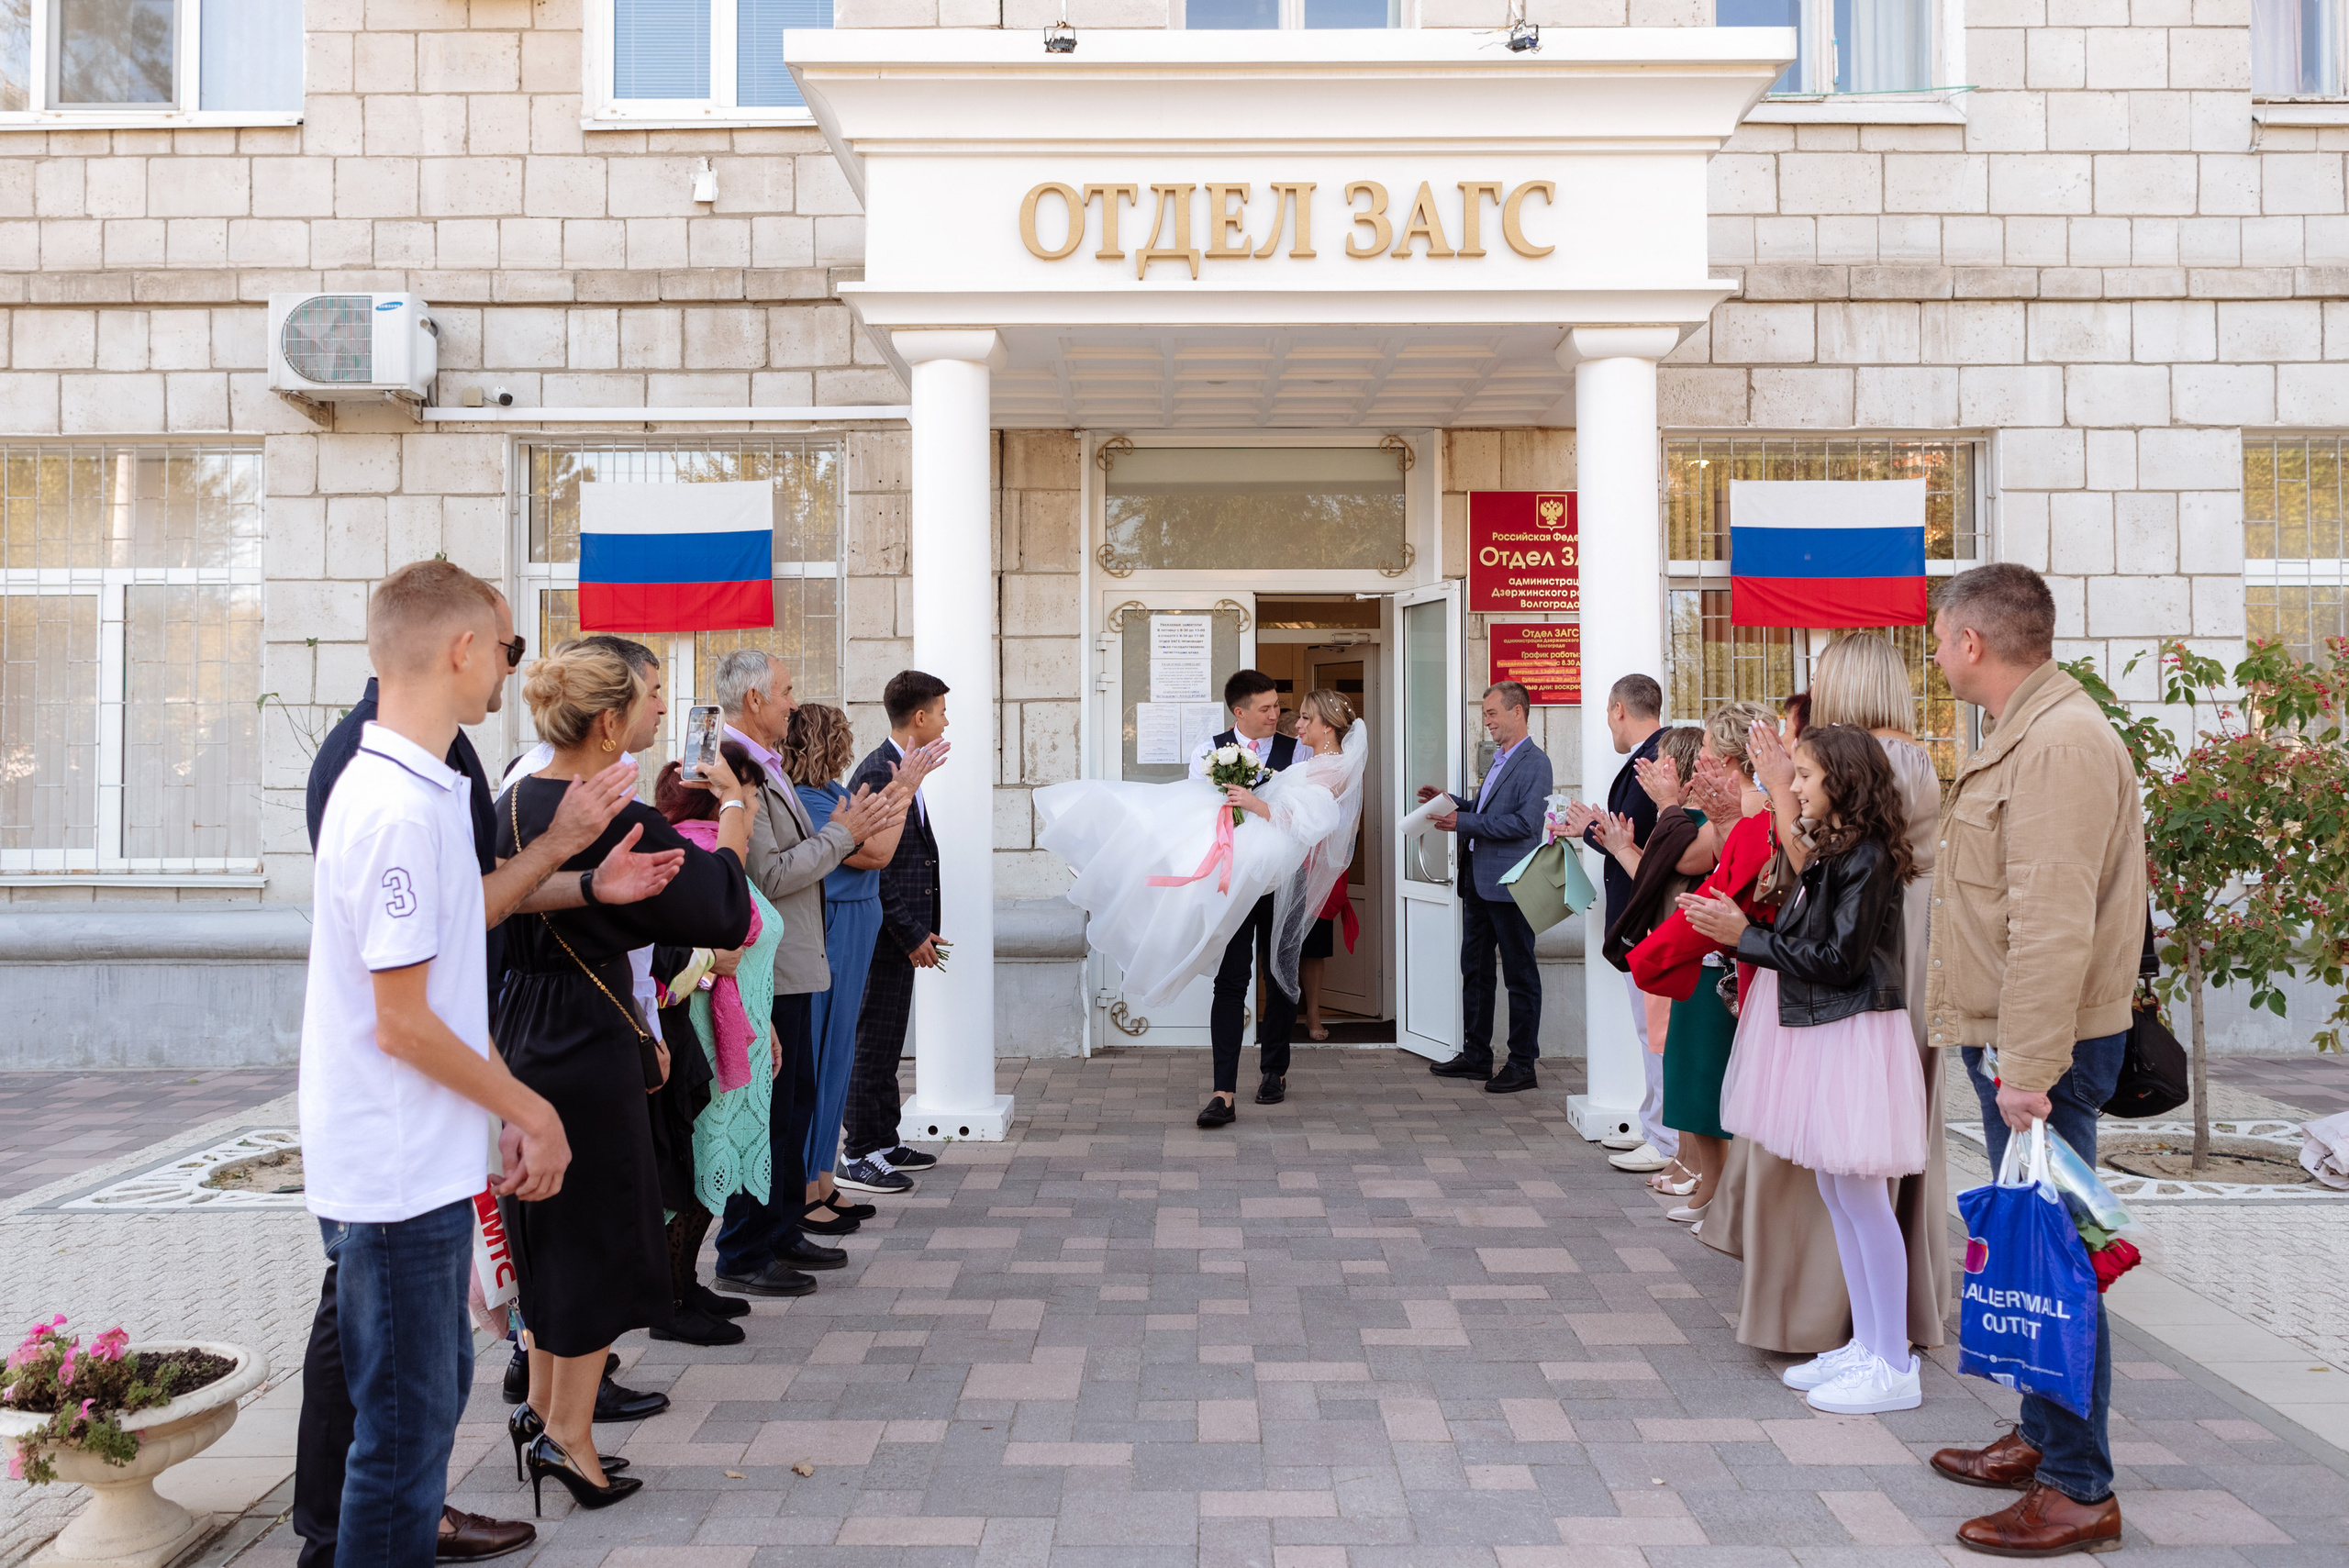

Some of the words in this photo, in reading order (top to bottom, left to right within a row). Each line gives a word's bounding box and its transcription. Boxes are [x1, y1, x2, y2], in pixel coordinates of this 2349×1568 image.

[1019, 181, 1318, 281] ОТДЕЛ
[1344, 180, 1557, 260] ЗАГС
[1492, 532, 1551, 541] Российская
[1553, 532, 1578, 542] Феде
[1479, 546, 1555, 569] Отдел
[1508, 577, 1579, 586] администрац
[1491, 587, 1568, 598] Дзержинского
[1520, 599, 1579, 609] Волгограда
[1521, 628, 1553, 639] Отдел
[1554, 628, 1579, 637] ЗАГС
[1521, 651, 1549, 659] График
[382, 866, 417, 918] 3
[1961, 1283, 2071, 1319] ALLERYMALL
